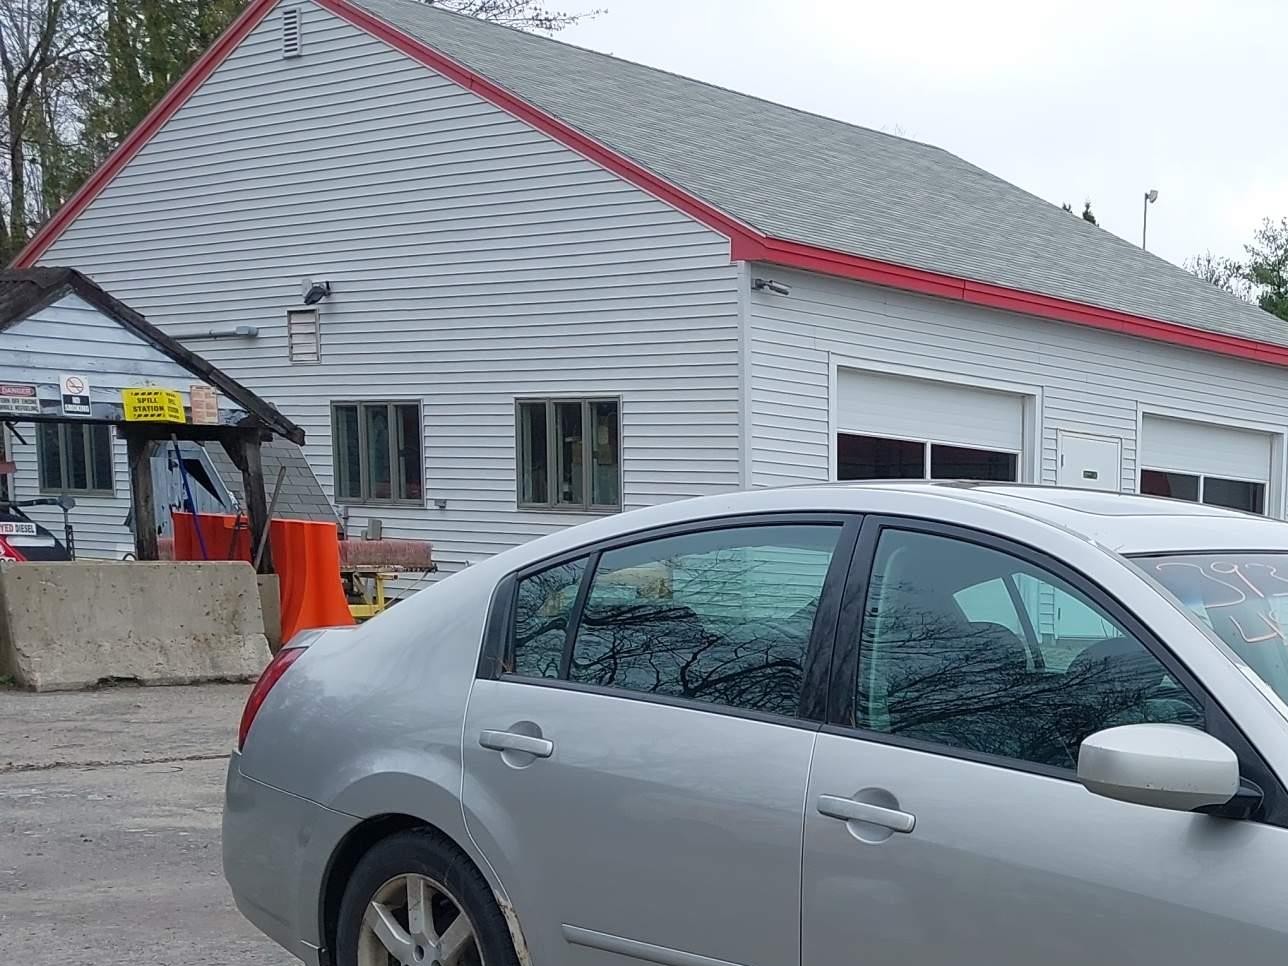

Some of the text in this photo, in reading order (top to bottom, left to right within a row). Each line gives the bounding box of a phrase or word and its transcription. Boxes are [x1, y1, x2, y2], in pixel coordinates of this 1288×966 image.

[1, 385, 32, 396] DANGER
[132, 405, 165, 413] STATION
[15, 524, 35, 533] DIESEL
